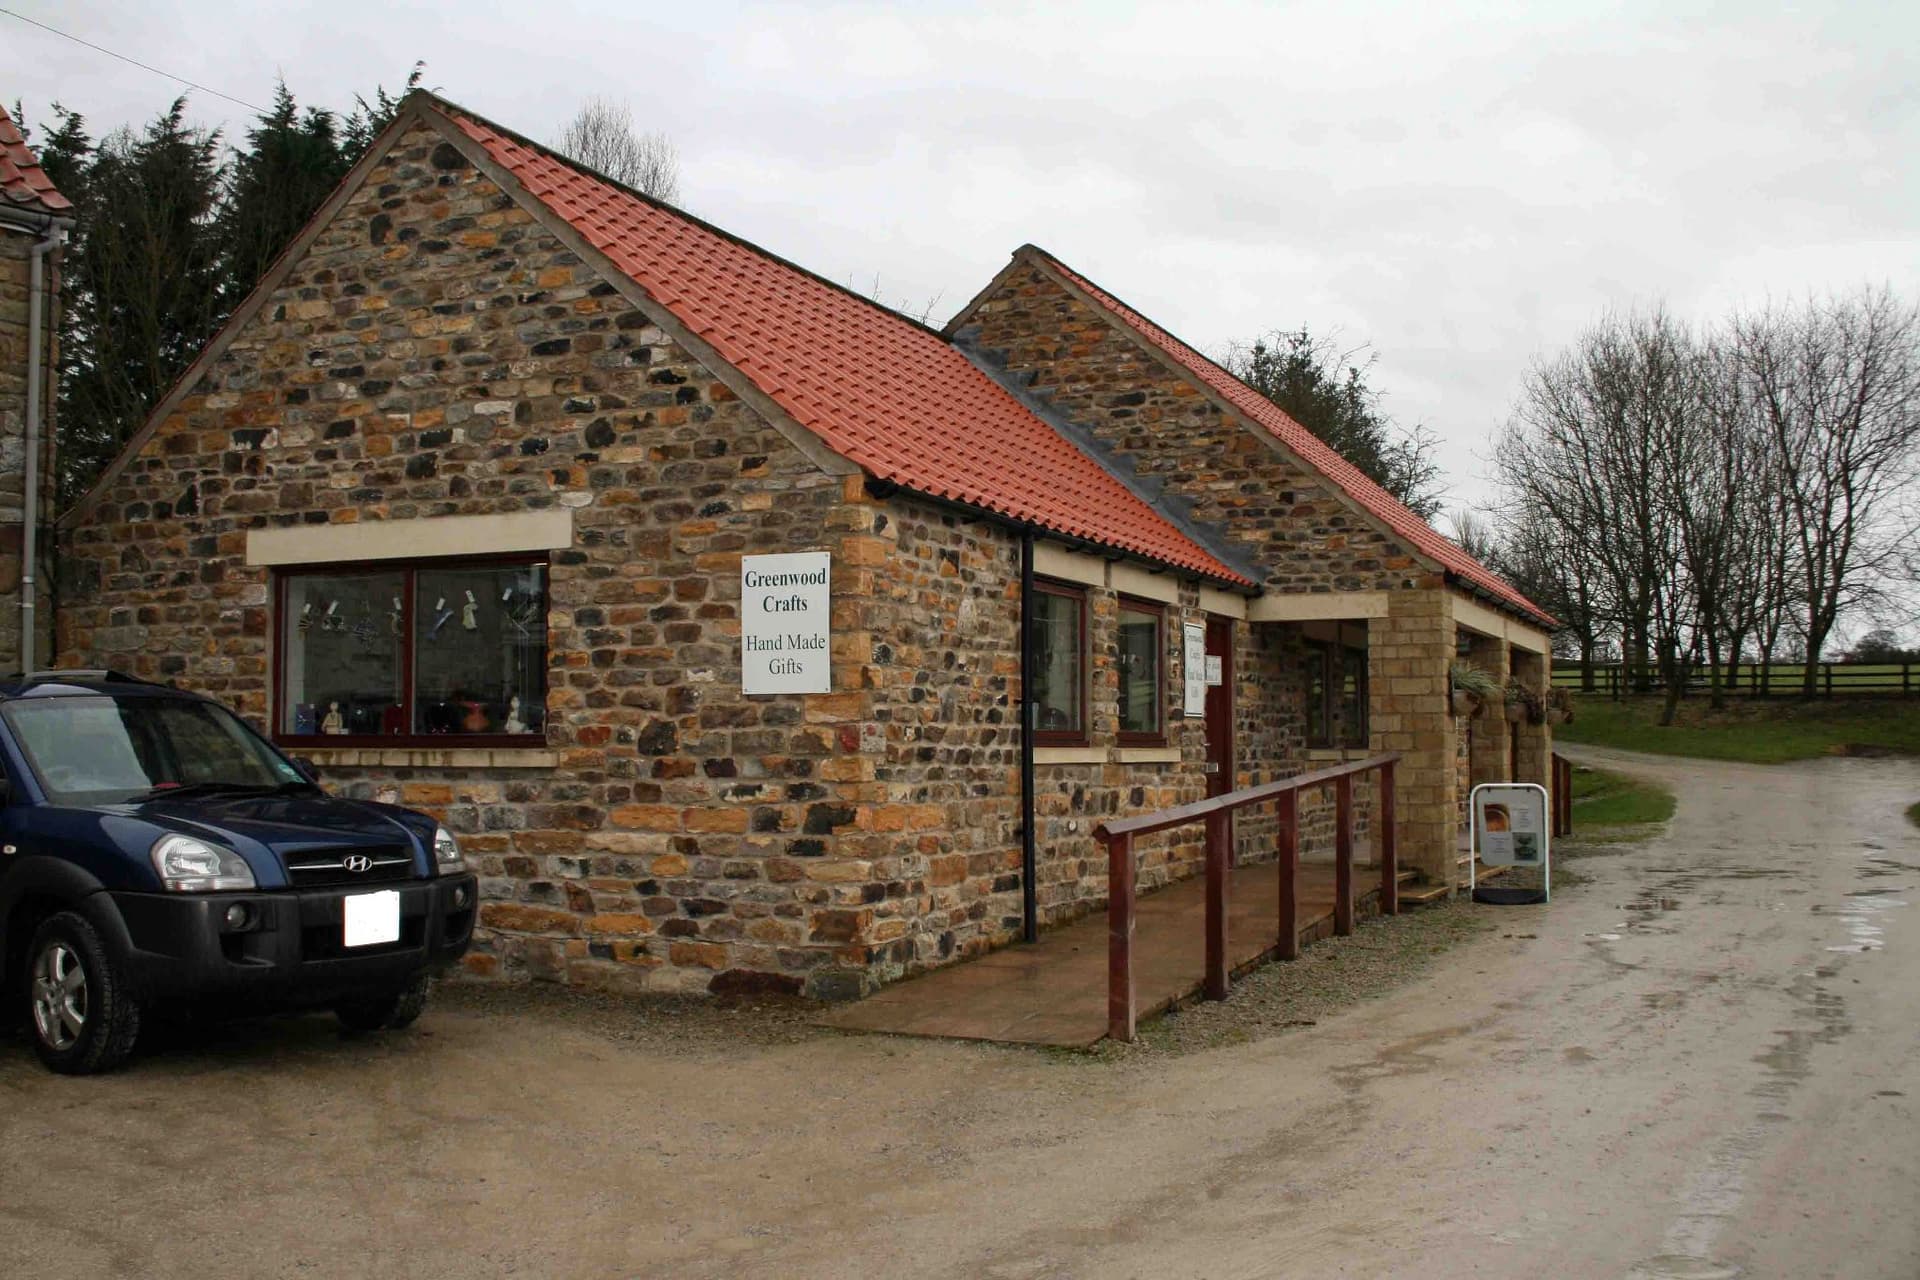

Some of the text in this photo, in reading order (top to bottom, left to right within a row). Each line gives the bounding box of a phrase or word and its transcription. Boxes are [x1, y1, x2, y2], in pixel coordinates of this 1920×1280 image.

[744, 568, 826, 588] Greenwood
[763, 594, 808, 612] Crafts
[746, 633, 826, 651] Hand Made
[768, 657, 803, 675] Gifts
